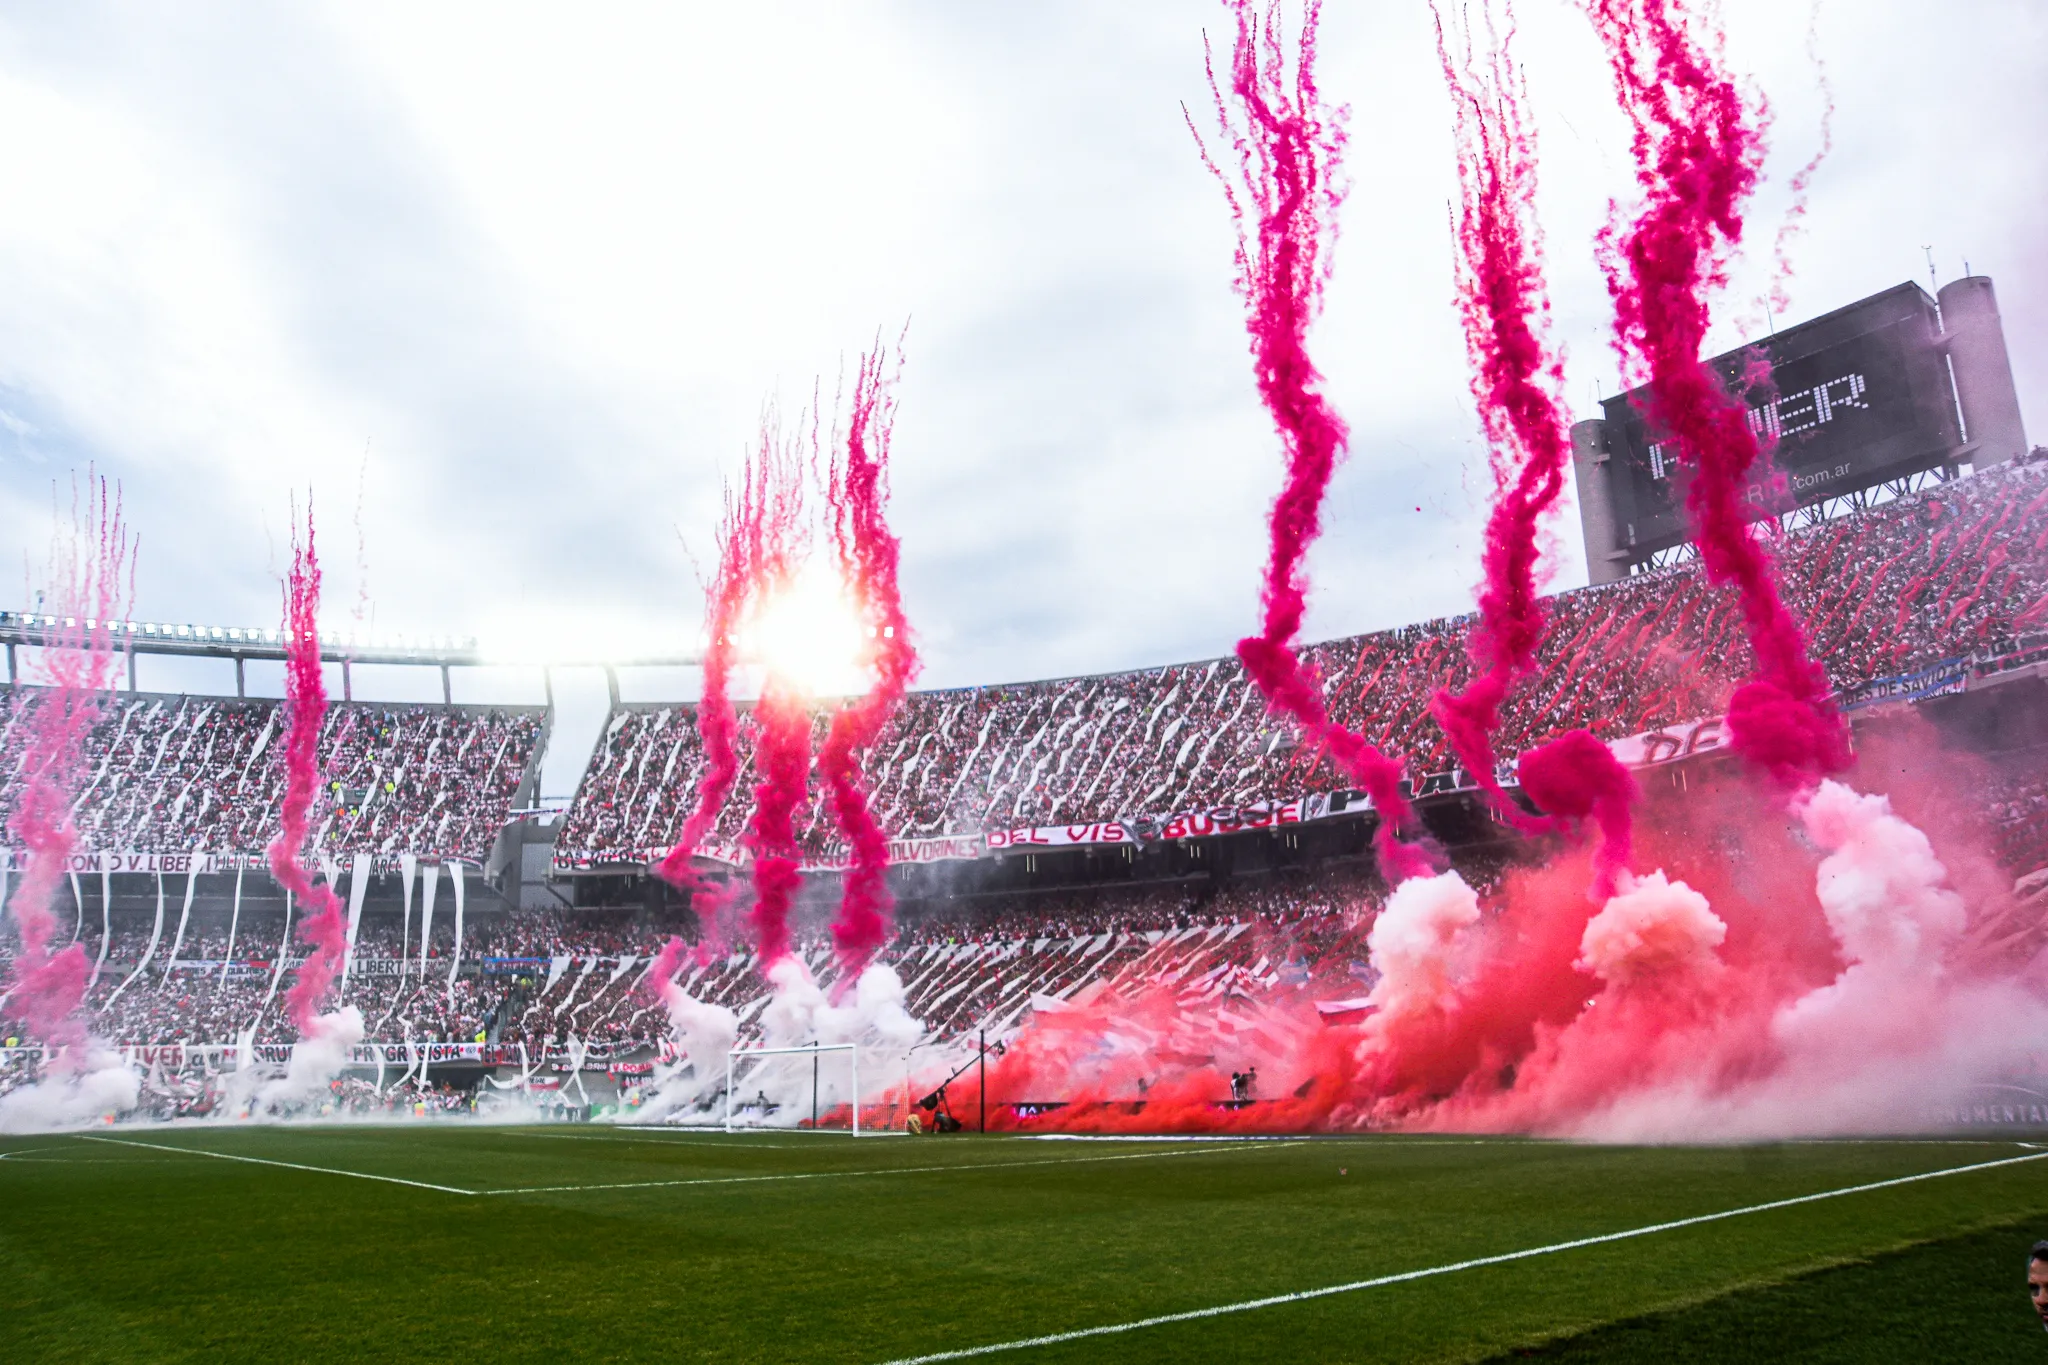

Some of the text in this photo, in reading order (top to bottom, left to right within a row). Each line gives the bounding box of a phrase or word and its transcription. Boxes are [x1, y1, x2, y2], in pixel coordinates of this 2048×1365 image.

[1648, 373, 1869, 481] RER
[1878, 680, 1897, 698] DE
[1901, 665, 1946, 695] SAVIO
[986, 820, 1128, 848] DEL VIS
[148, 855, 211, 872] LIBERI
[357, 961, 406, 974] LIBERT
[353, 1044, 461, 1063] PRGRSISTA
